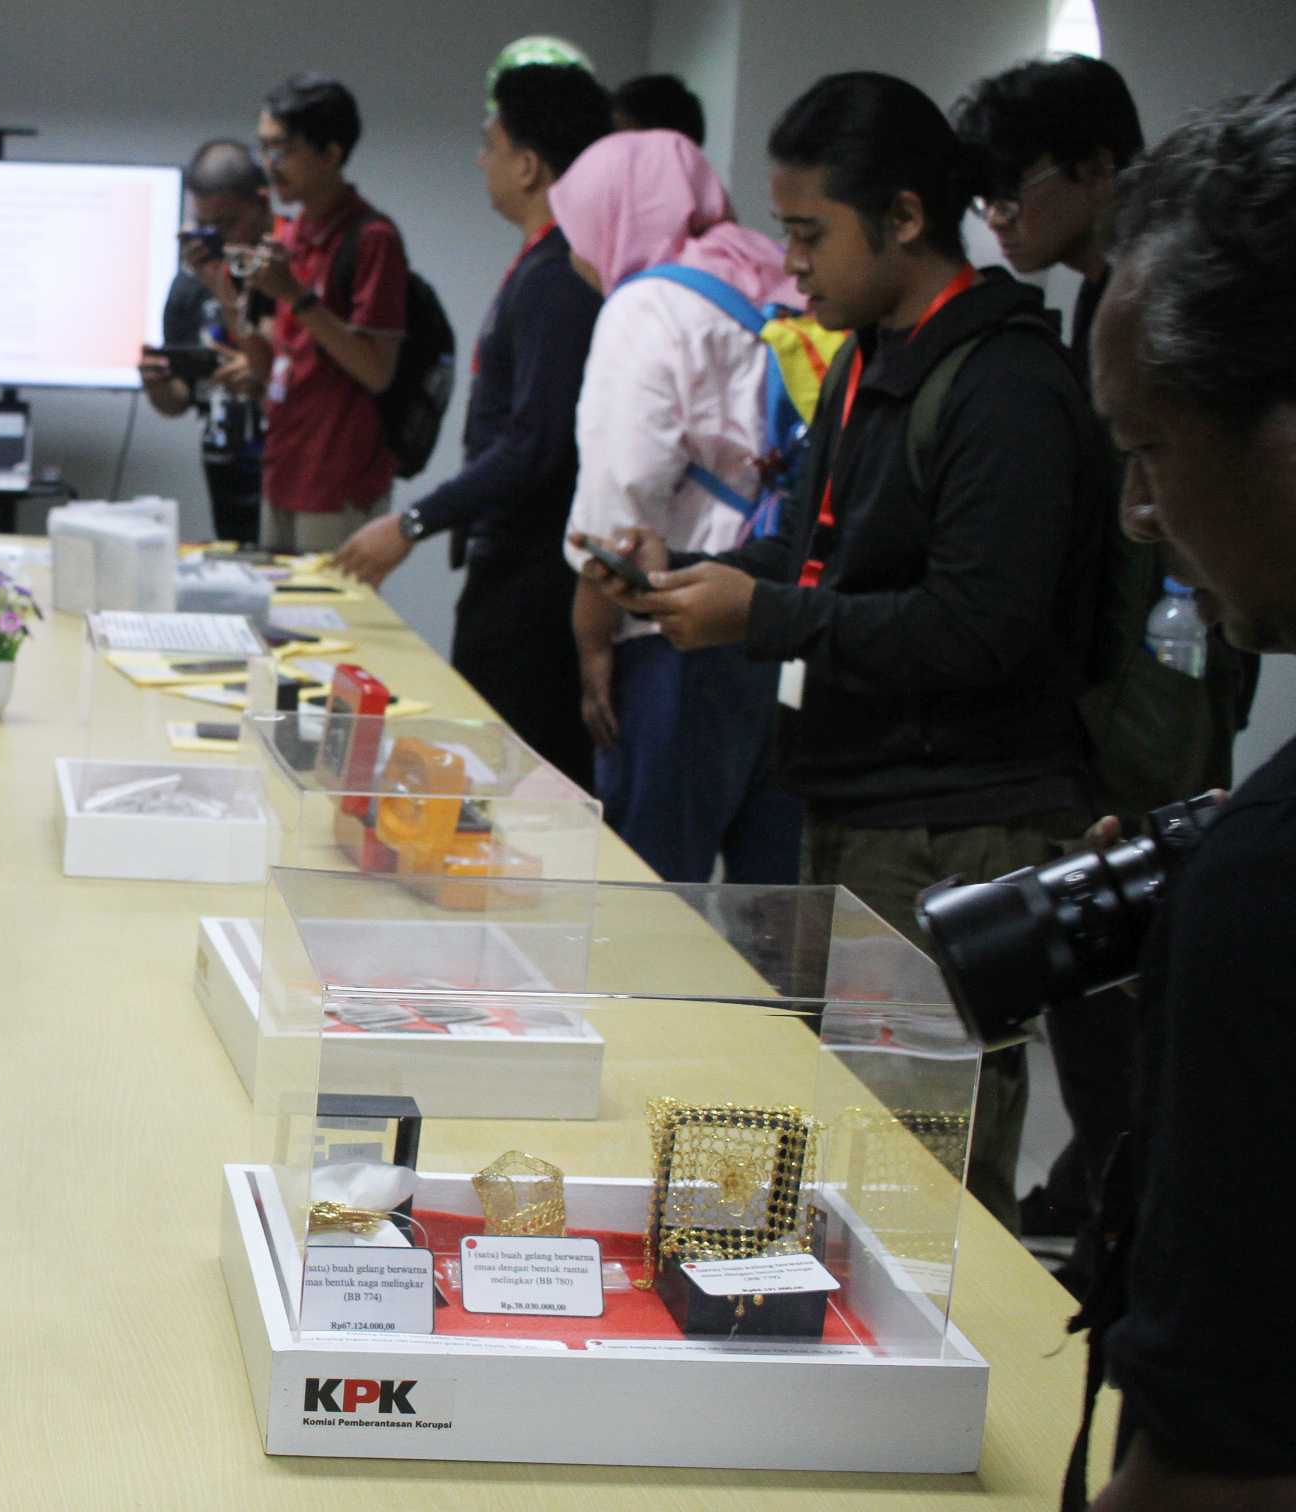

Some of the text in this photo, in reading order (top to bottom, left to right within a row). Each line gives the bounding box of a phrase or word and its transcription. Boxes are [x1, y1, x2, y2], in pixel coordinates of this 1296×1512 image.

[474, 1251, 499, 1260] (satu)
[501, 1251, 523, 1259] buah
[524, 1252, 552, 1262] gelang
[554, 1252, 594, 1261] berwarna
[305, 1264, 427, 1275] (satu) buah gelang berwarna
[498, 1263, 529, 1273] dengan
[531, 1264, 560, 1273] bentuk
[563, 1266, 589, 1274] rantai
[305, 1278, 424, 1289] mas bentuk naga melingkar
[491, 1276, 573, 1287] melingkar (BB 780)
[343, 1293, 382, 1302] (BB 774)
[331, 1322, 395, 1331] Rp67.124.000,00
[304, 1377, 418, 1415] KPK
[303, 1417, 452, 1430] Komisi Pemberantasan Korupsi
